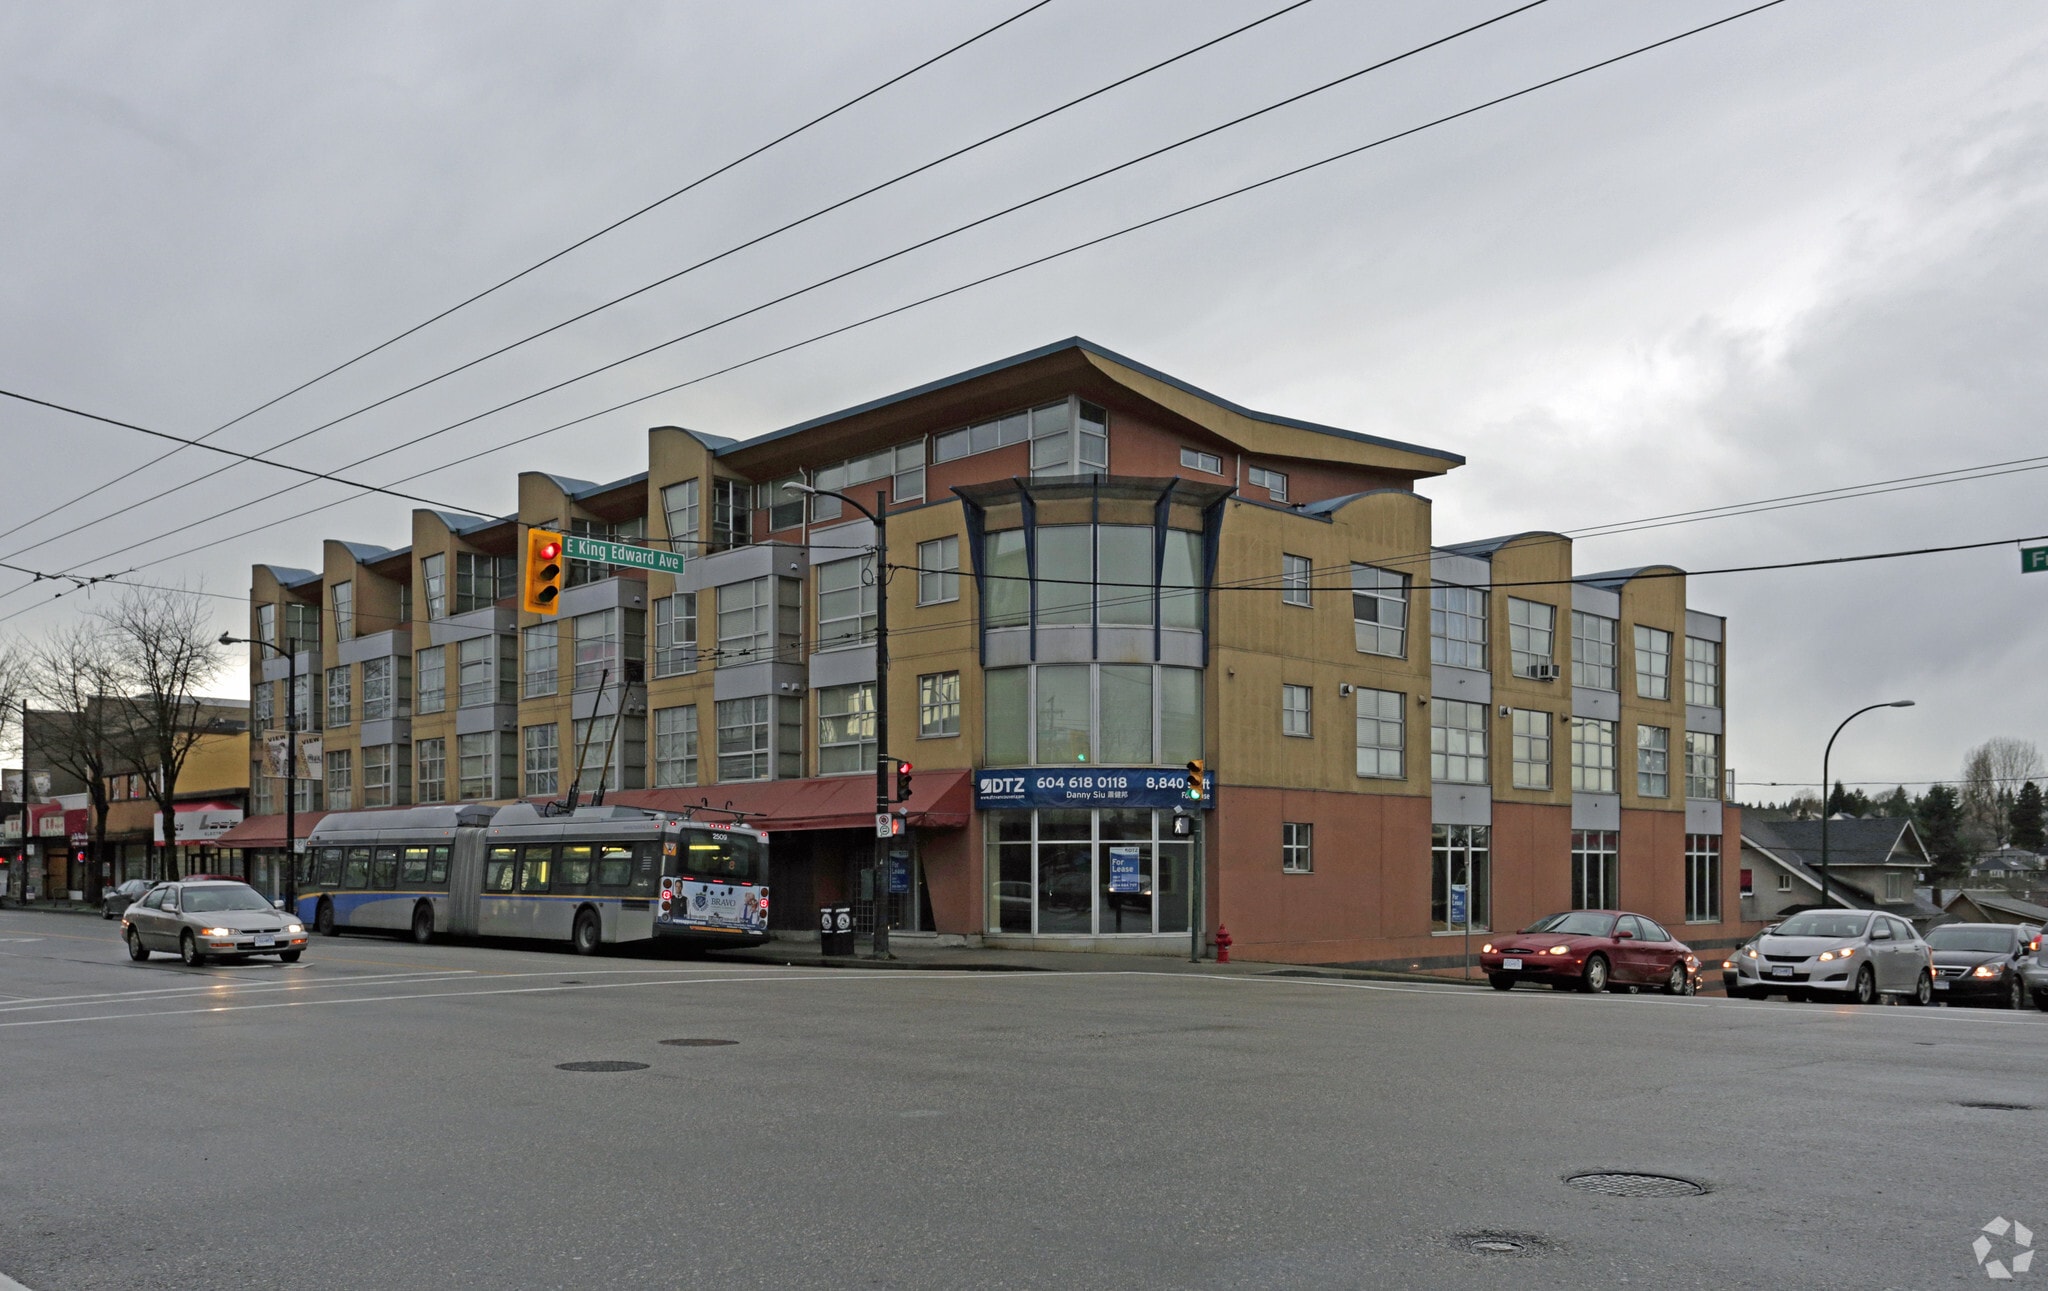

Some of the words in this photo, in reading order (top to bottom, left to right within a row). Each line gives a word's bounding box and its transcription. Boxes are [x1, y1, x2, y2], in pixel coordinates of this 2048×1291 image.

[566, 539, 573, 552] E
[579, 540, 606, 561] King
[611, 545, 655, 565] Edward
[659, 554, 679, 569] Ave
[992, 778, 1025, 793] DTZ
[1036, 777, 1065, 789] 604
[1069, 777, 1093, 789] 618
[1097, 777, 1128, 789] 0118
[1146, 777, 1184, 790] 8,840
[1066, 791, 1091, 800] Danny
[1093, 791, 1106, 799] Siu
[729, 860, 735, 870] 8
[1112, 858, 1124, 866] For
[711, 897, 736, 907] BRAVO
